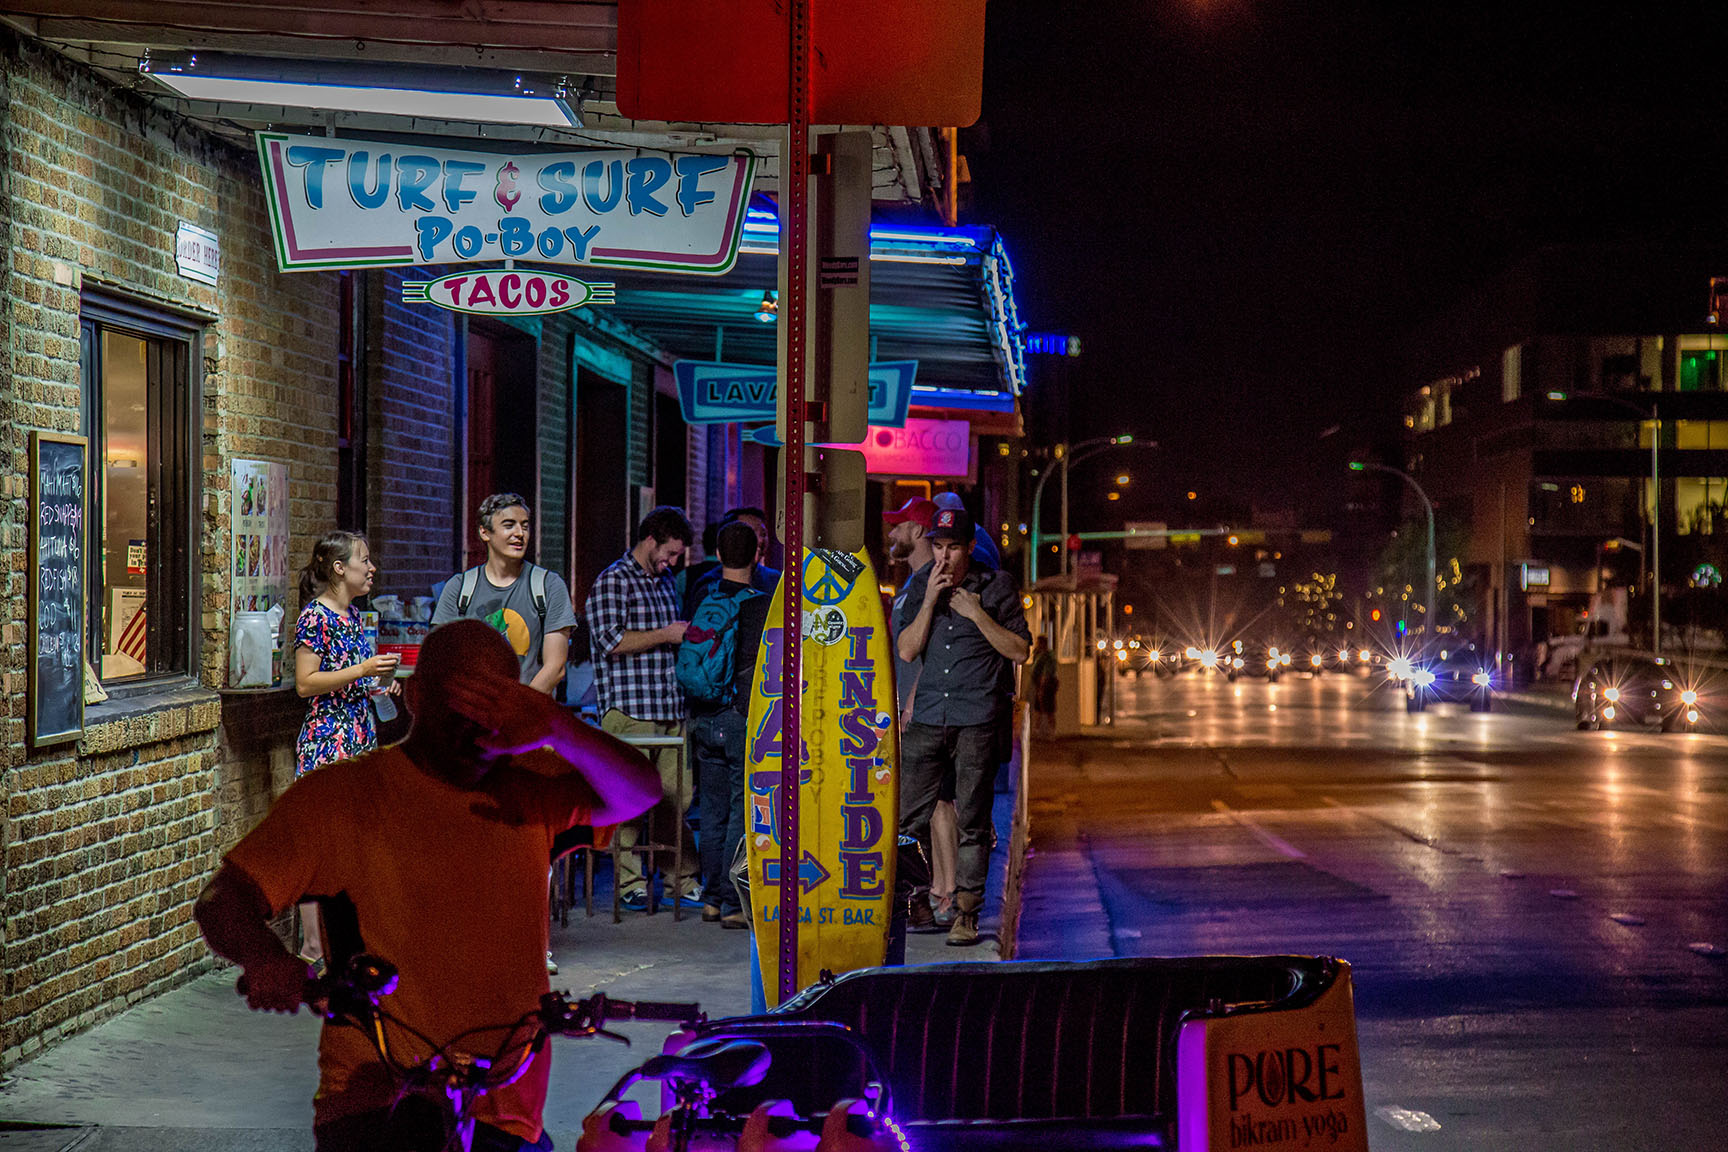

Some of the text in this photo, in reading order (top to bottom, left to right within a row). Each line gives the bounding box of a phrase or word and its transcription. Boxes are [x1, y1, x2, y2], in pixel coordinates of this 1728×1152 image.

[286, 145, 486, 213] TURF
[537, 156, 729, 217] SURF
[414, 216, 601, 263] PO-BOY
[444, 274, 570, 309] TACOS
[840, 626, 886, 899] INSIDE
[843, 908, 876, 926] BAR
[1226, 1045, 1345, 1111] PURE
[1229, 1110, 1348, 1149] bikram yoga
